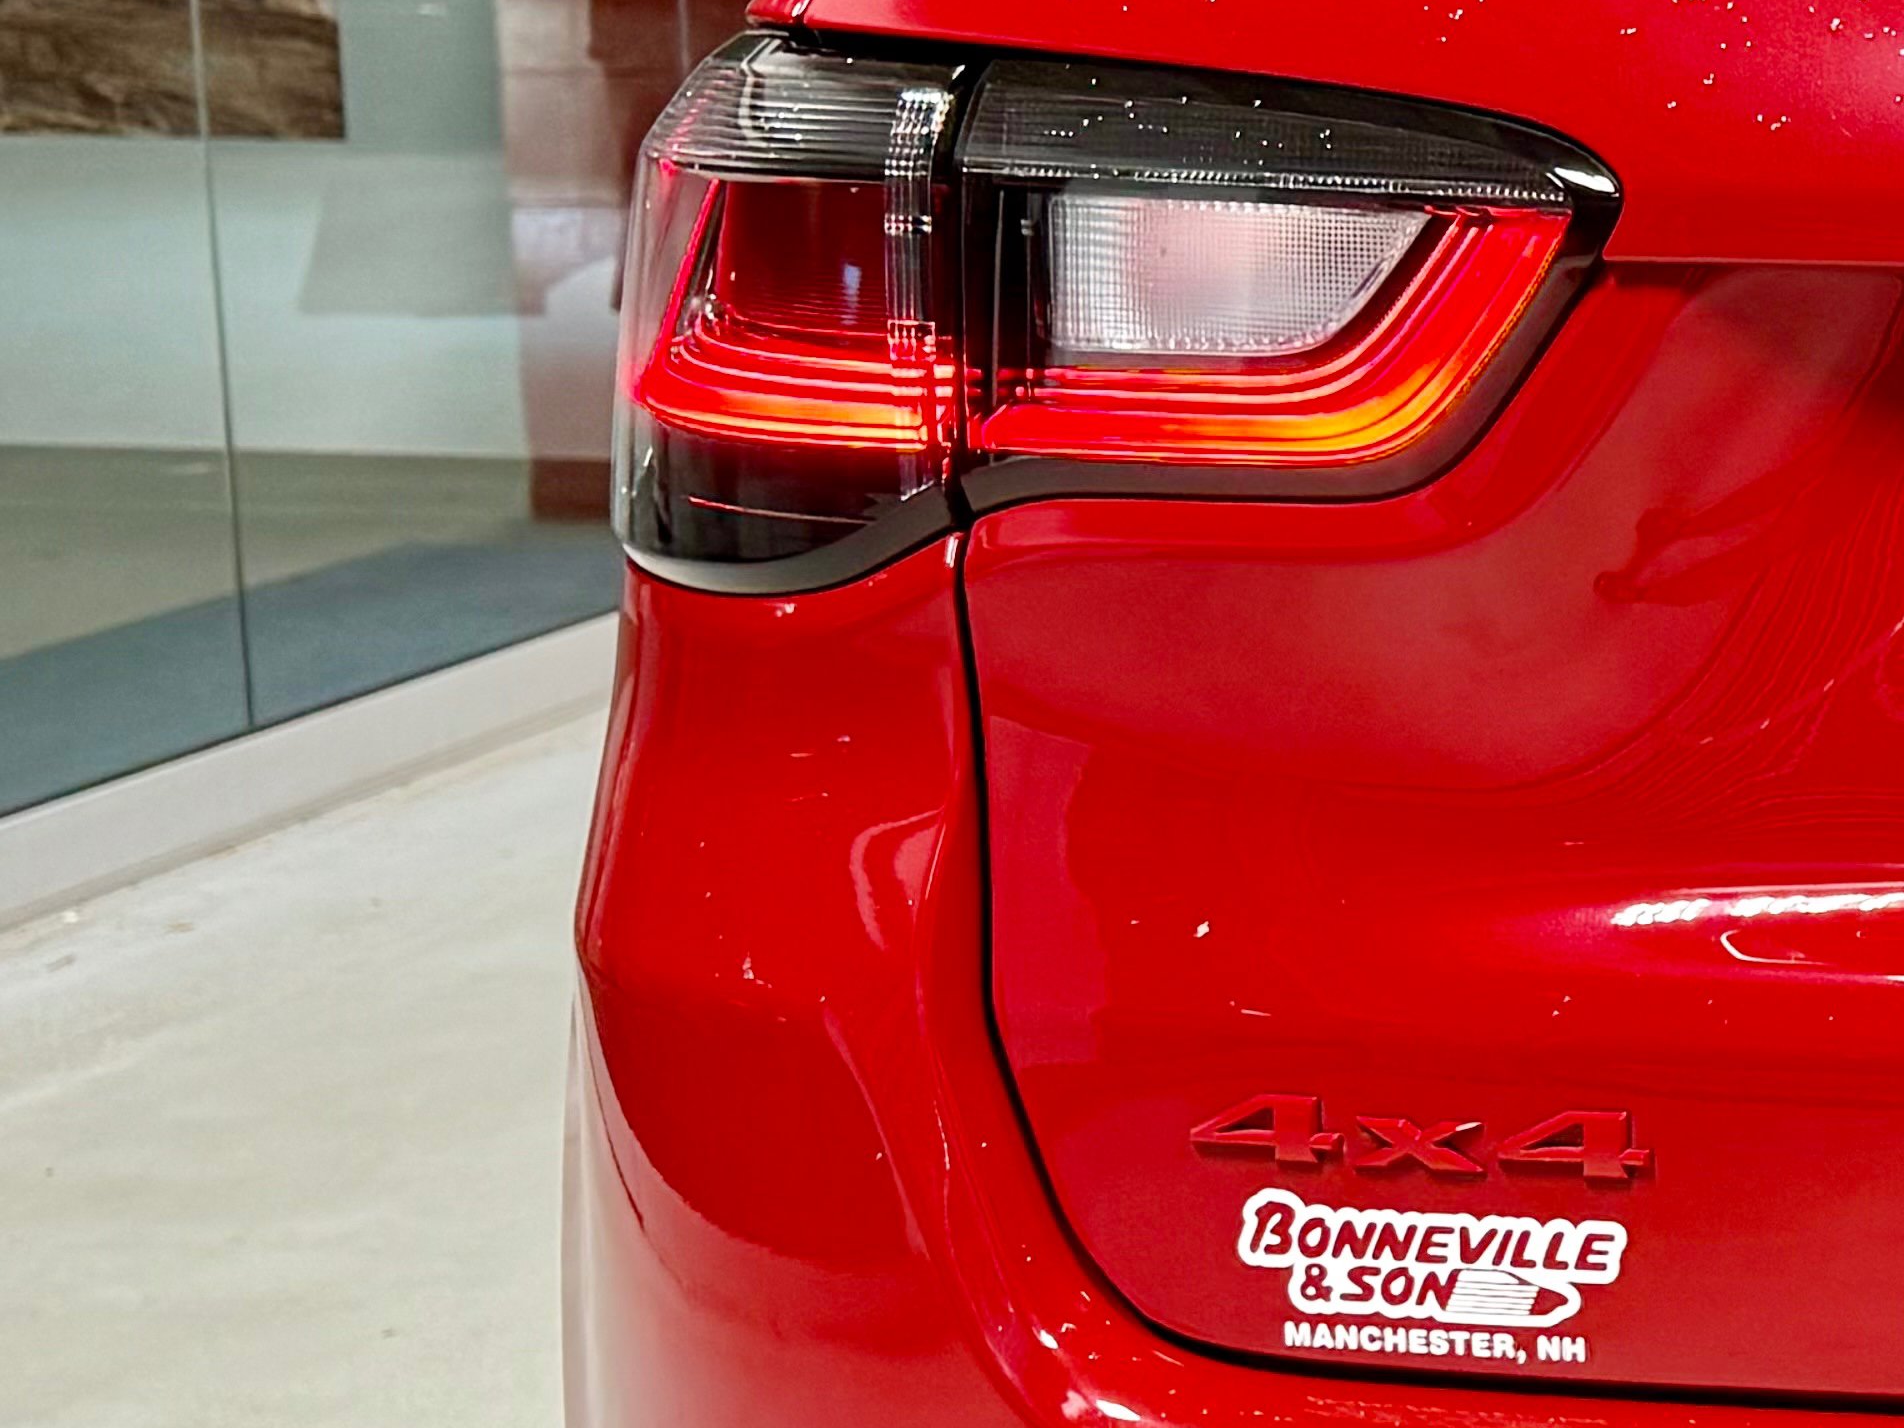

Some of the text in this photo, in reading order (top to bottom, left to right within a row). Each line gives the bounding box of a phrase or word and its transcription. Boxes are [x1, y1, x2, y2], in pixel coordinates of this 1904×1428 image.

[1189, 1094, 1657, 1181] 4x4
[1249, 1199, 1616, 1272] BONNEVILLE
[1299, 1262, 1458, 1308] & SON
[1283, 1320, 1587, 1365] MANCHESTER, NH
